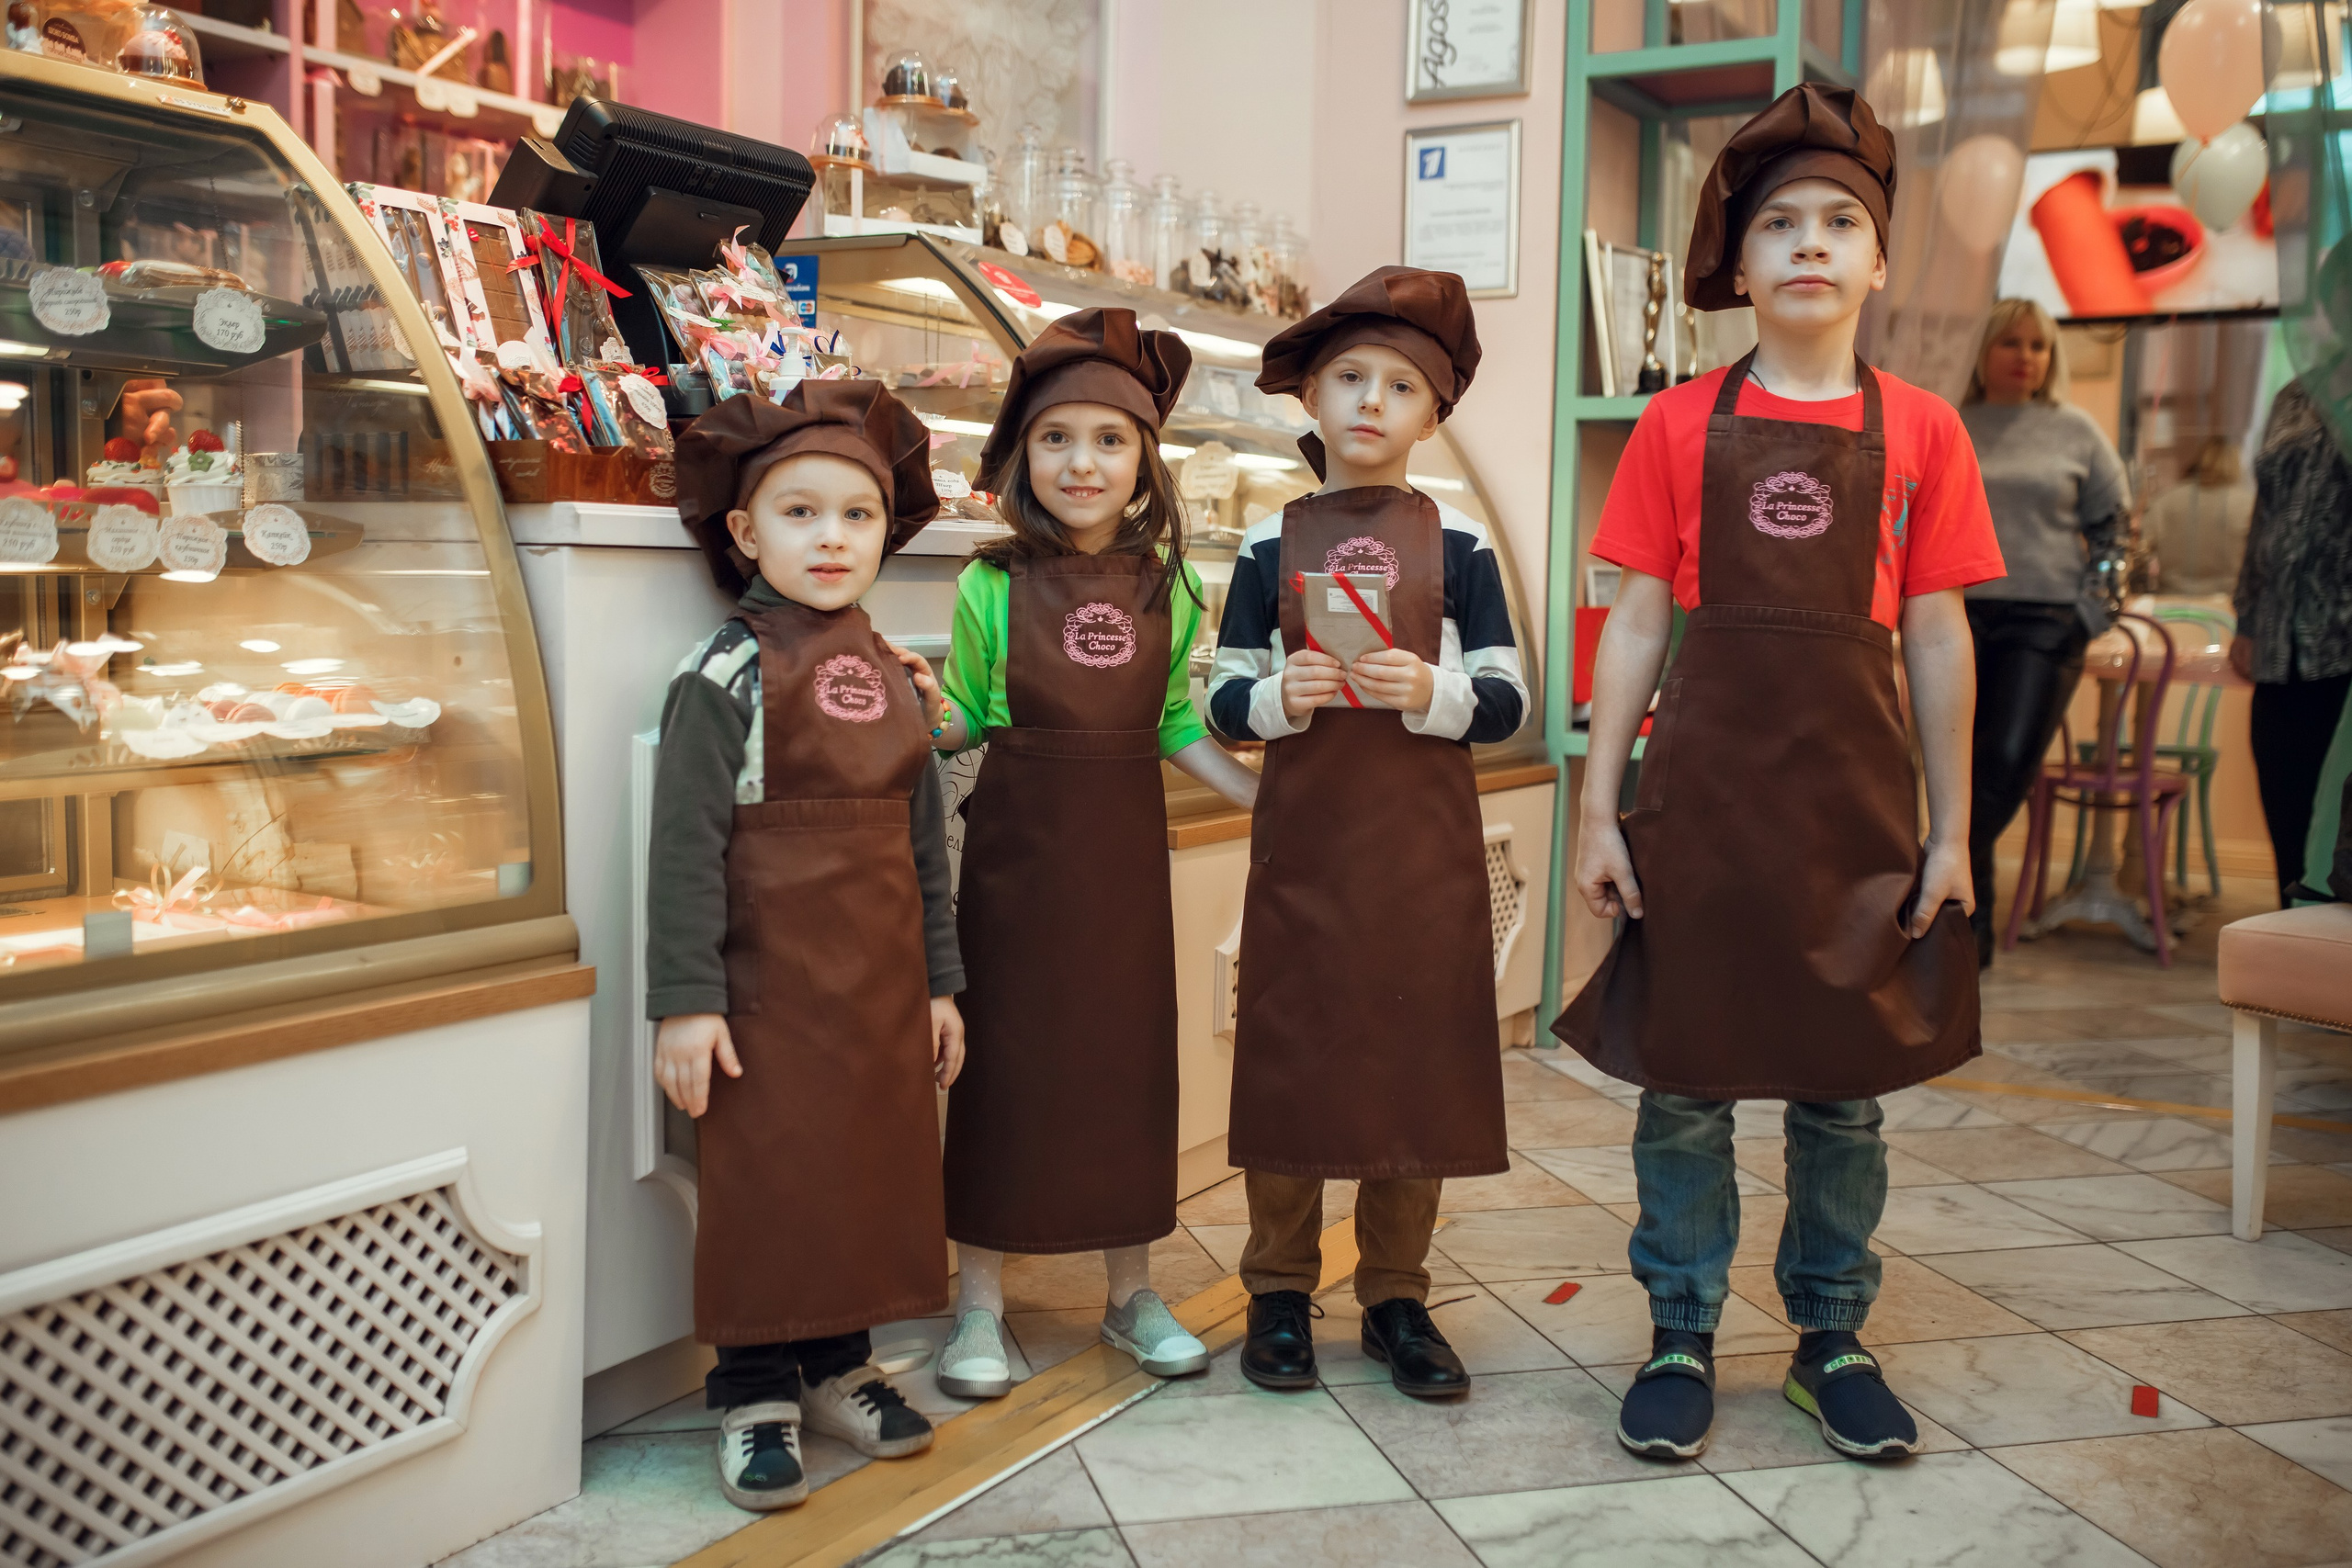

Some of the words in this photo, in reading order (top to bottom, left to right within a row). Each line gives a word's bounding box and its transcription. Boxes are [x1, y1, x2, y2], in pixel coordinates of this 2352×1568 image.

[231, 331, 243, 341] руб
[1762, 502, 1774, 510] La
[1776, 502, 1820, 512] Princesse
[1777, 511, 1807, 521] Choco
[271, 542, 287, 552] 250р
[1348, 562, 1388, 571] Princesse
[1075, 632, 1085, 640] La
[1088, 632, 1126, 641] Princesse
[1089, 641, 1115, 650] Choco
[827, 685, 838, 694] La
[840, 685, 876, 697] Princesse
[842, 694, 866, 705] Choco
